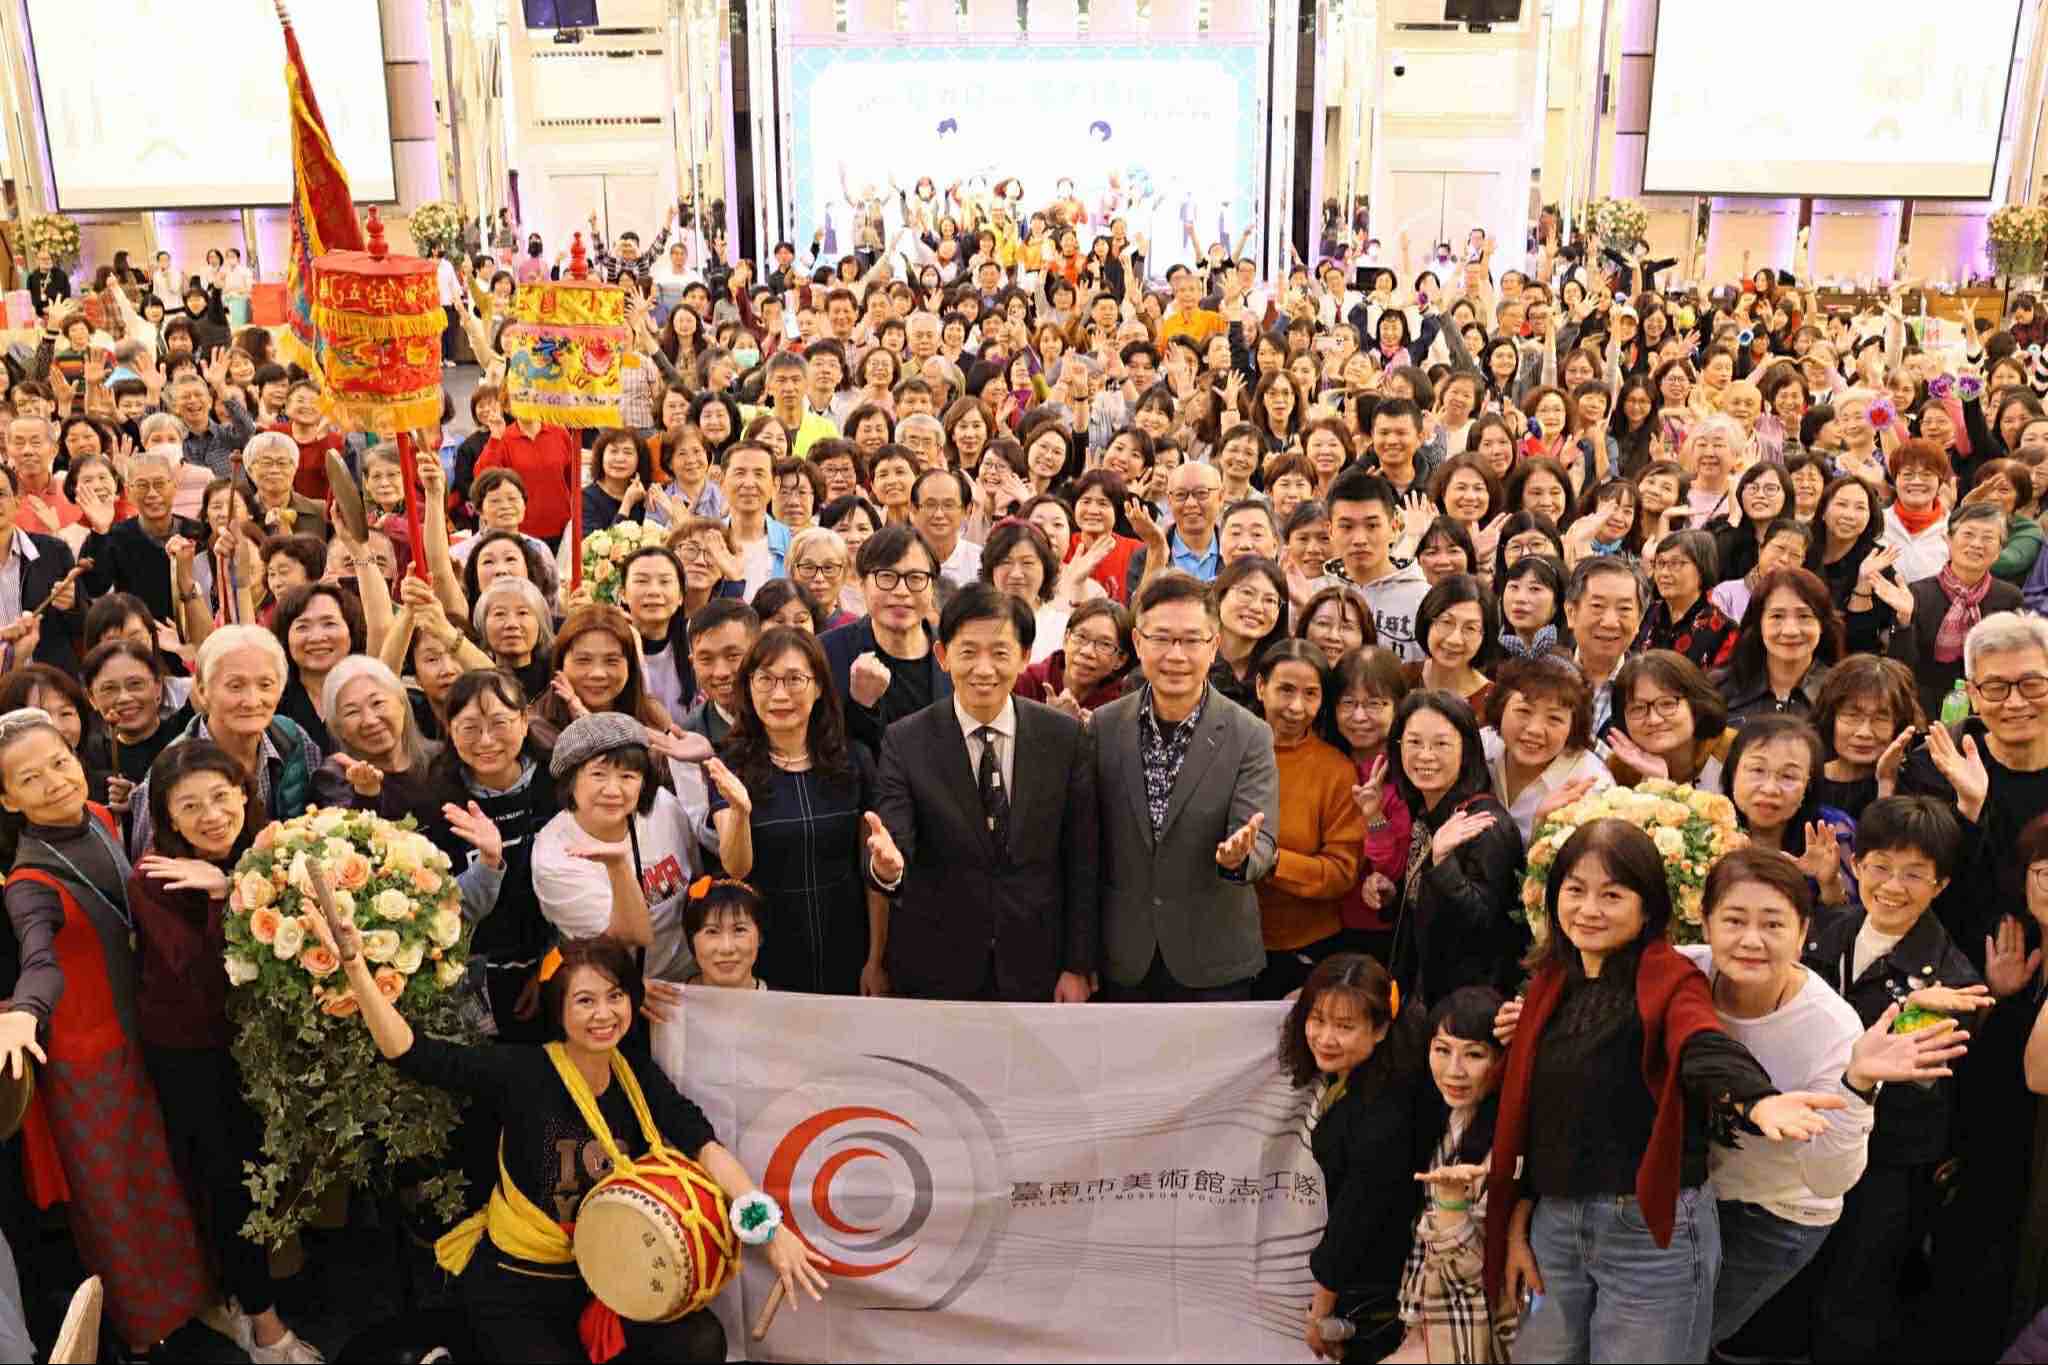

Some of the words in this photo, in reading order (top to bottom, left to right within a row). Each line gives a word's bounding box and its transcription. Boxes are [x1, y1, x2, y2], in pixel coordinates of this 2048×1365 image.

[1011, 1168, 1321, 1201] 臺南市美術館志工隊
[1115, 1192, 1178, 1201] MUSEUM
